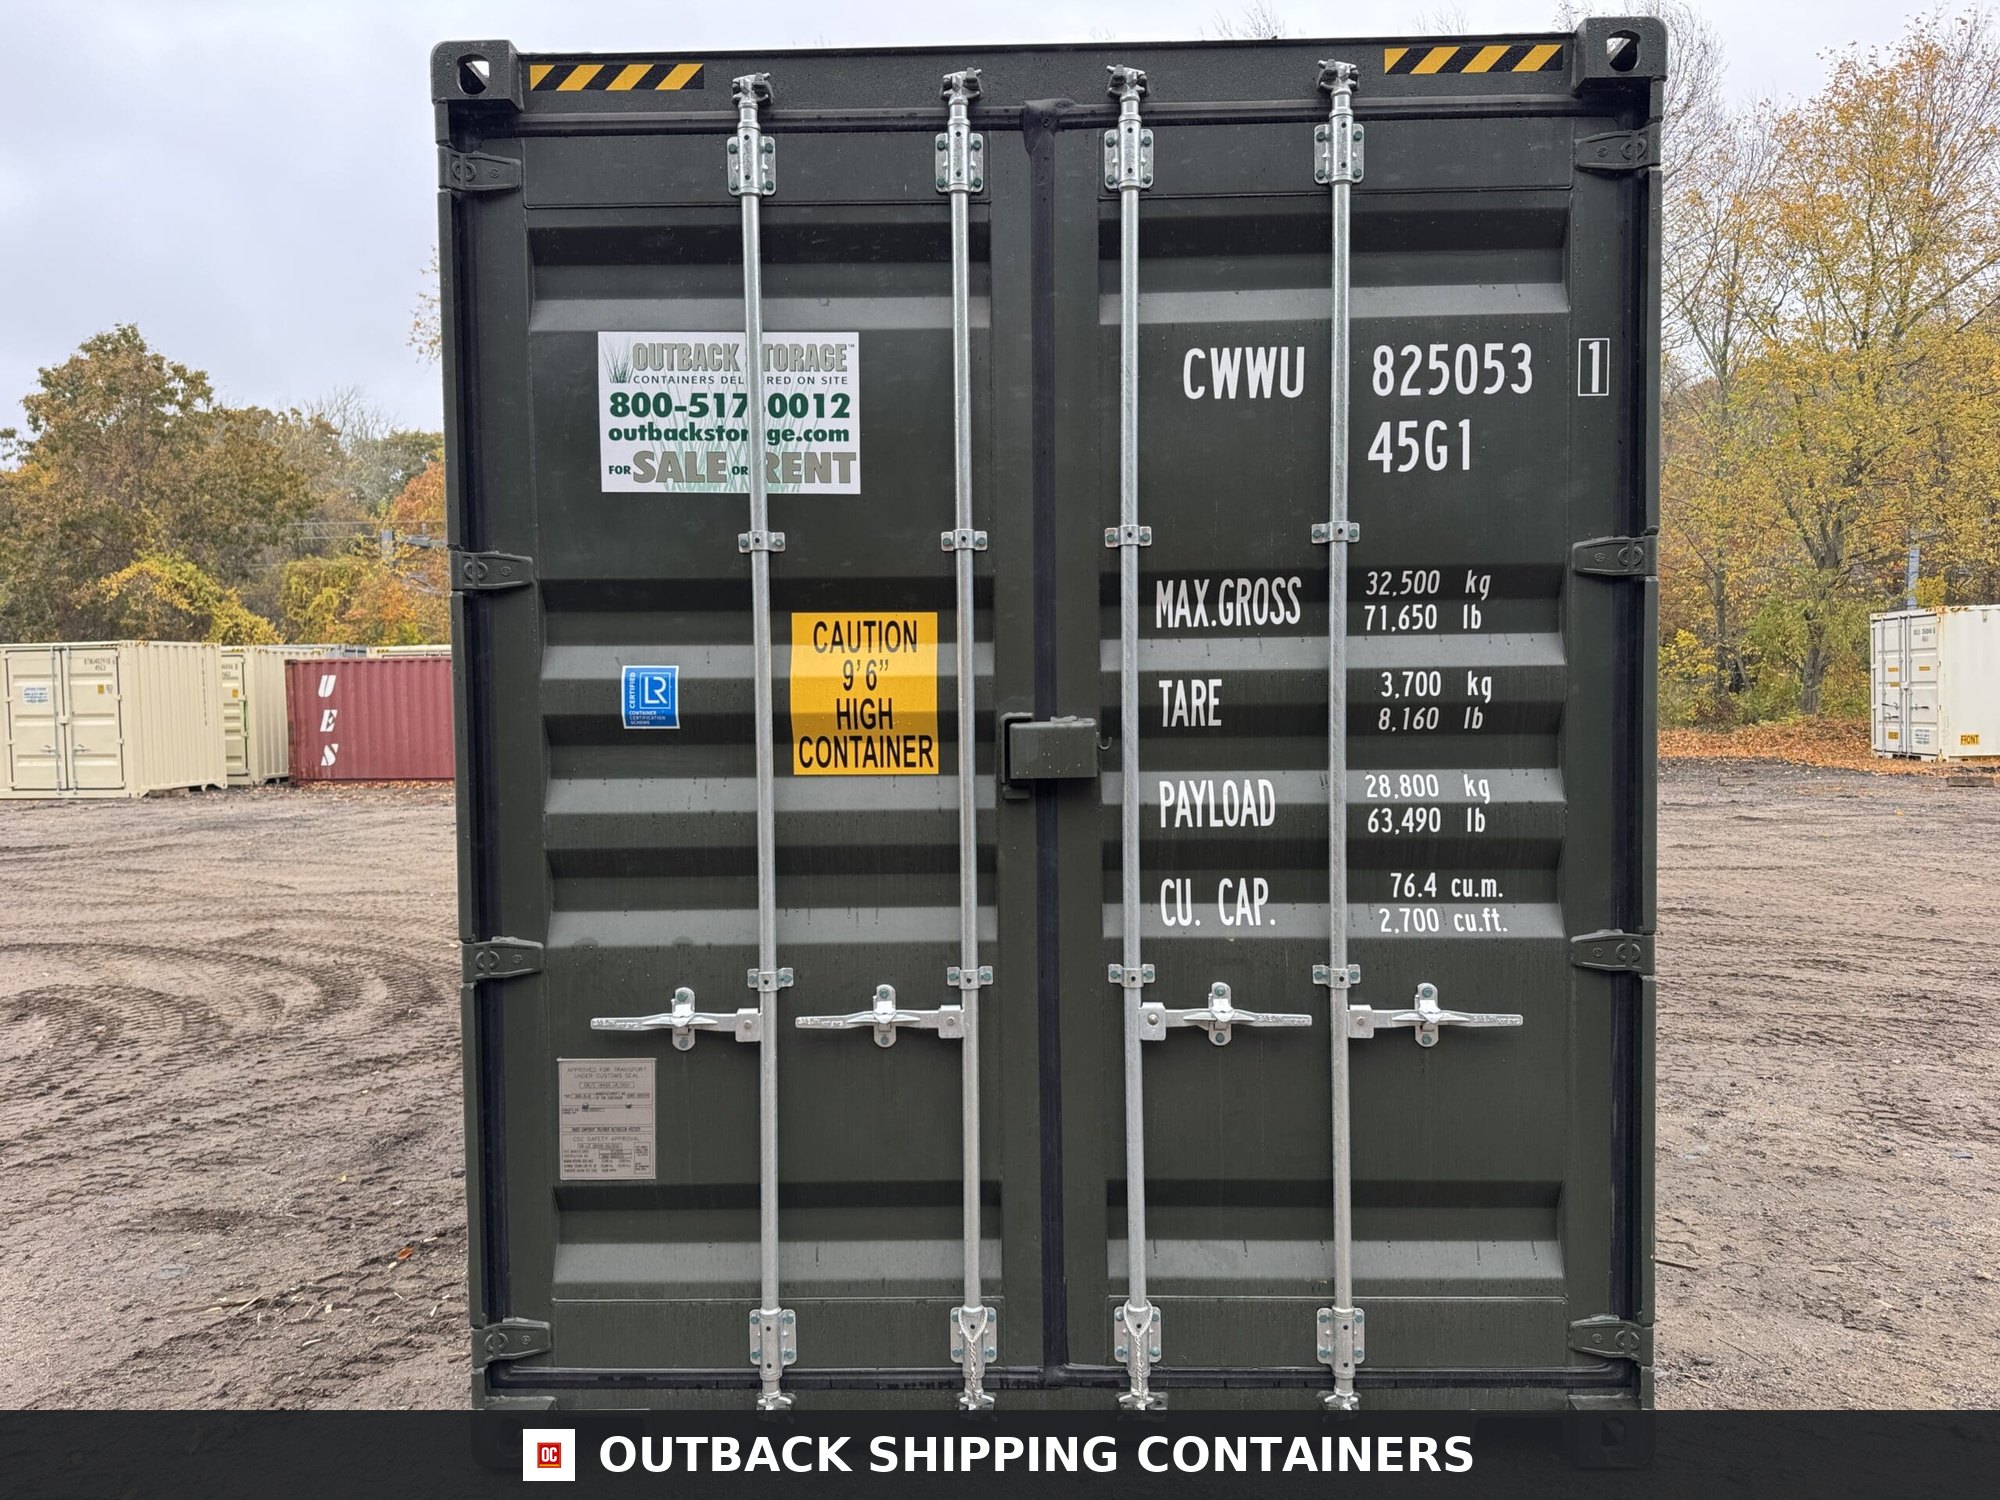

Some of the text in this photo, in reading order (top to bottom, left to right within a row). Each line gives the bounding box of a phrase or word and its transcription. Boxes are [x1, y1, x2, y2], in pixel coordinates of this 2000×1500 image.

[632, 343, 740, 372] OUTBACK
[745, 343, 848, 372] TORAGE
[1183, 341, 1600, 400] CWWU 825053 1
[633, 375, 849, 385] CONTAINERS DELRED ON SITE
[609, 392, 851, 419] 800-5170012
[608, 422, 850, 446] outbackstorge.com
[1367, 418, 1472, 473] 45G1
[608, 465, 631, 475] FOR
[633, 450, 728, 484] SALE
[731, 466, 749, 475] OR
[1155, 569, 1491, 629] MAX.GROSS 32,500 kg
[1364, 604, 1481, 632] 71,650 lb
[813, 620, 918, 654] CAUTION
[836, 697, 894, 730] HIGH
[1158, 670, 1492, 728] TARE 3,700 kg
[1378, 706, 1483, 732] 8,160 lb
[799, 735, 935, 769] CONTAINER
[1158, 779, 1276, 829] PAYLOAD
[1463, 773, 1491, 804] kg
[1367, 807, 1486, 835] 63,490 lb
[1160, 872, 1503, 927] CU. CAP. 76.4 cu.m.
[1378, 907, 1508, 934] 2,700 cu.ft.
